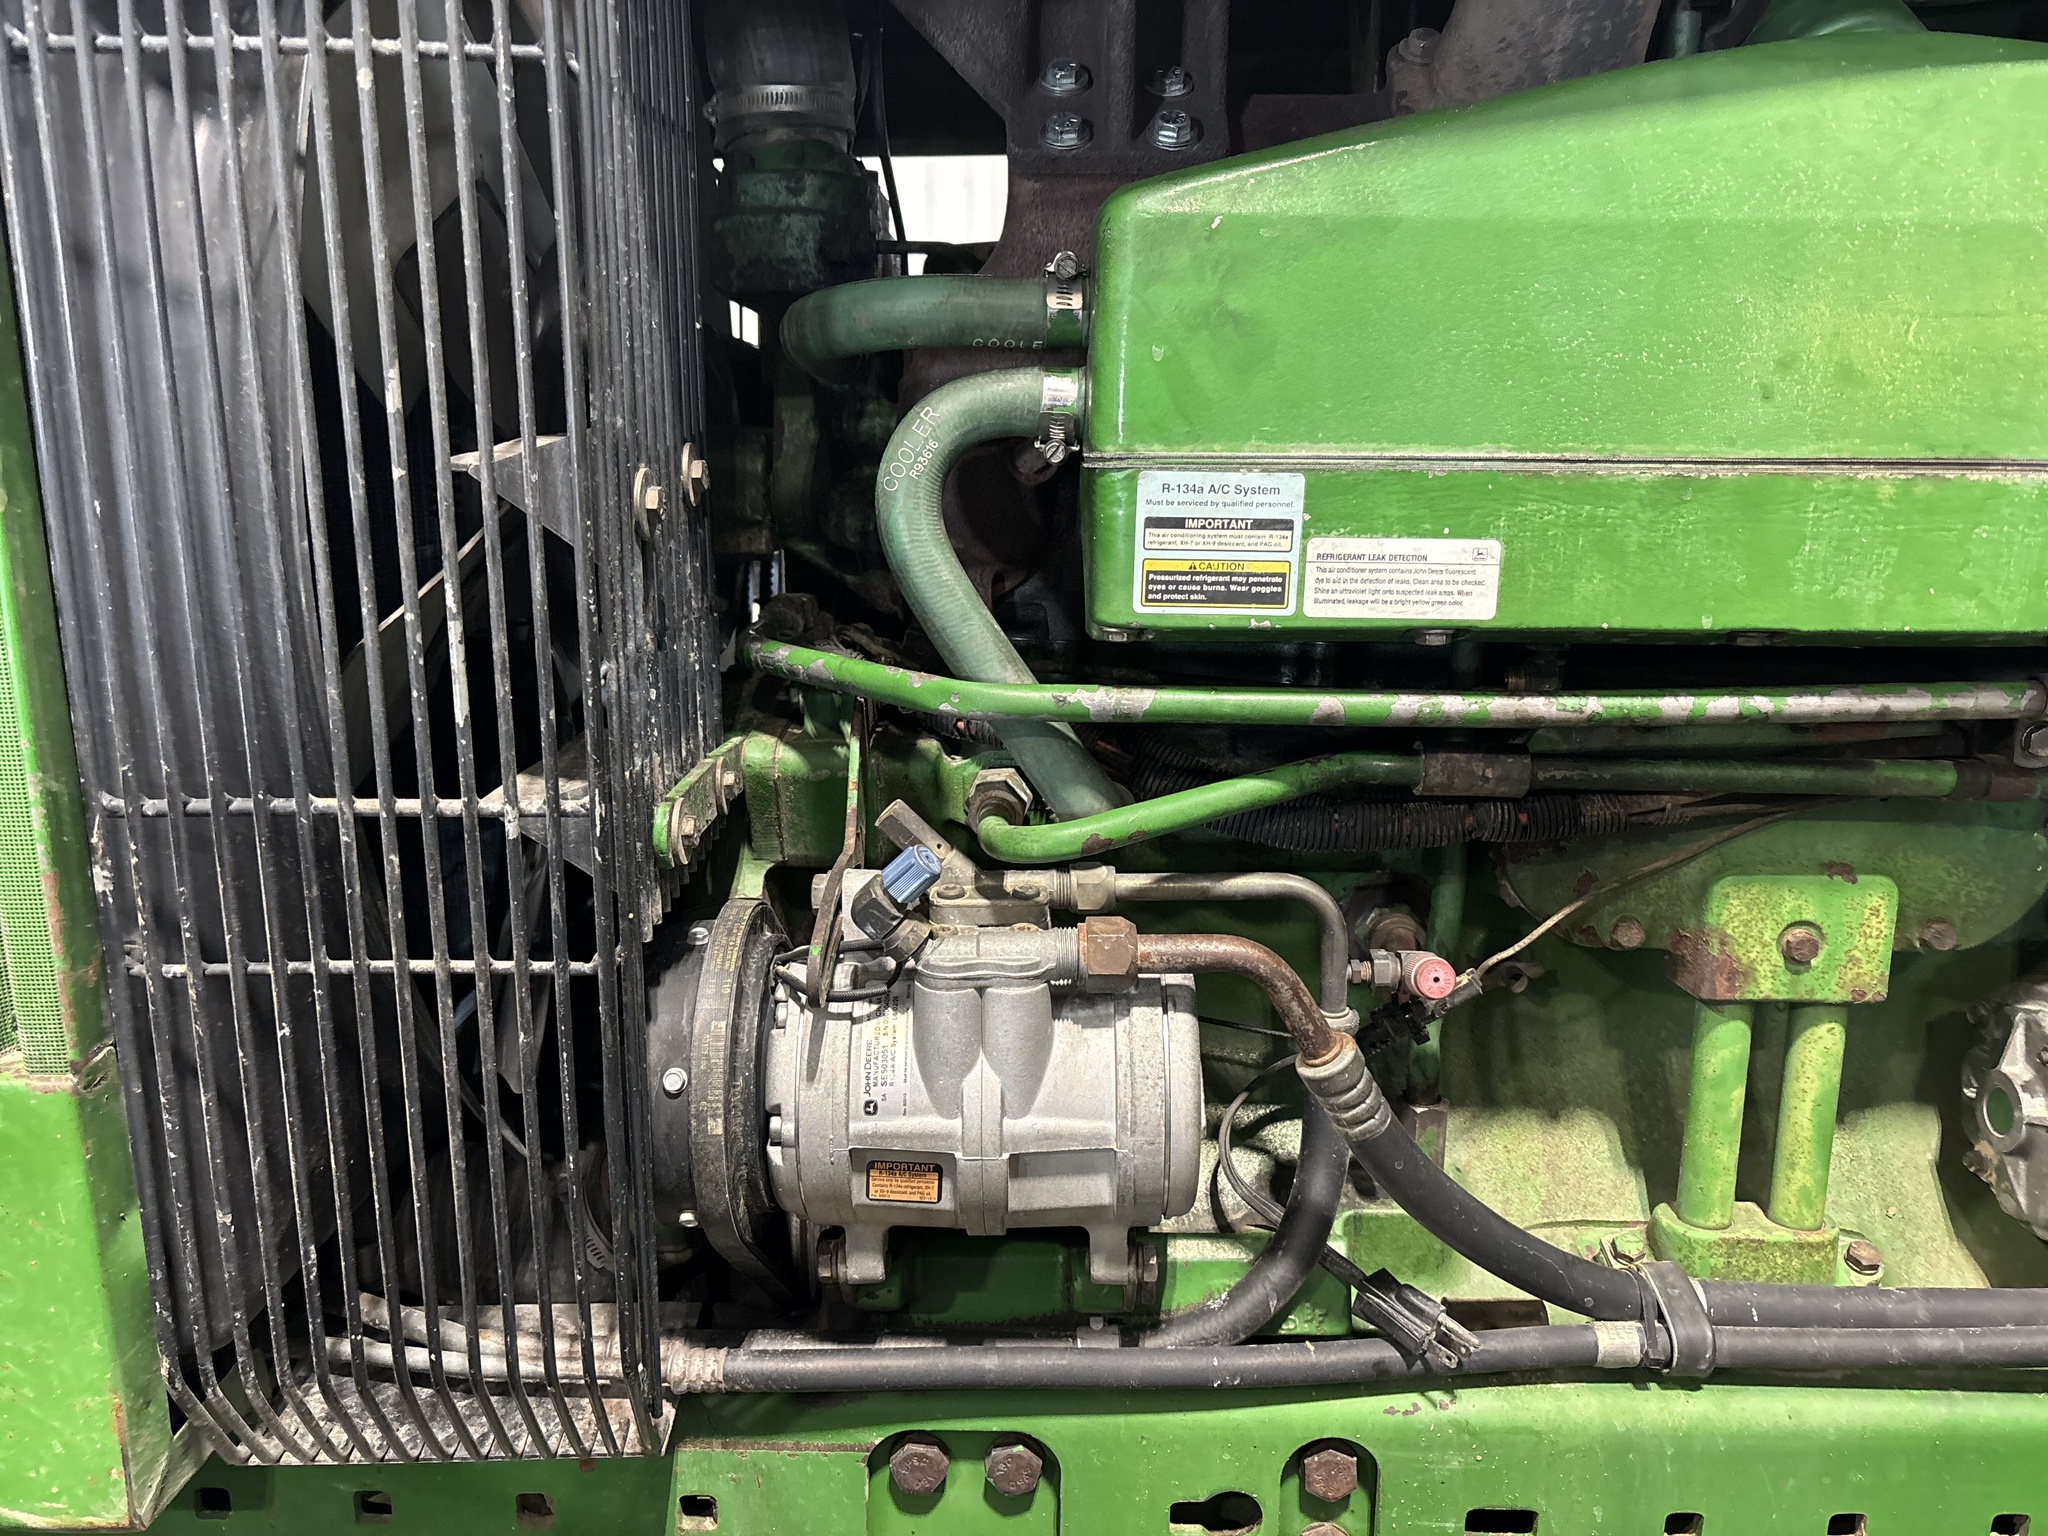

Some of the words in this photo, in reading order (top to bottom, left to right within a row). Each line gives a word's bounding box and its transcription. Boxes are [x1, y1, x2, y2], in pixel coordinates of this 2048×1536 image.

[883, 406, 940, 492] COOLER
[909, 439, 939, 479] R93616
[1162, 483, 1203, 494] R-134a
[1208, 484, 1230, 494] A/C
[1234, 484, 1281, 497] System
[1211, 500, 1219, 508] by
[1222, 500, 1253, 508] qualified
[1185, 519, 1253, 529] IMPORTANT
[1199, 562, 1244, 570] CAUTION
[1192, 575, 1230, 583] refrigerant
[1249, 576, 1282, 584] penetrate
[1251, 585, 1282, 593] goggles
[864, 1040, 872, 1070] DEERE
[872, 1026, 880, 1087] MANUFACTURED
[863, 1072, 871, 1097] JOHN
[881, 1093, 887, 1102] SA
[875, 1162, 935, 1172] IMPORTANT
